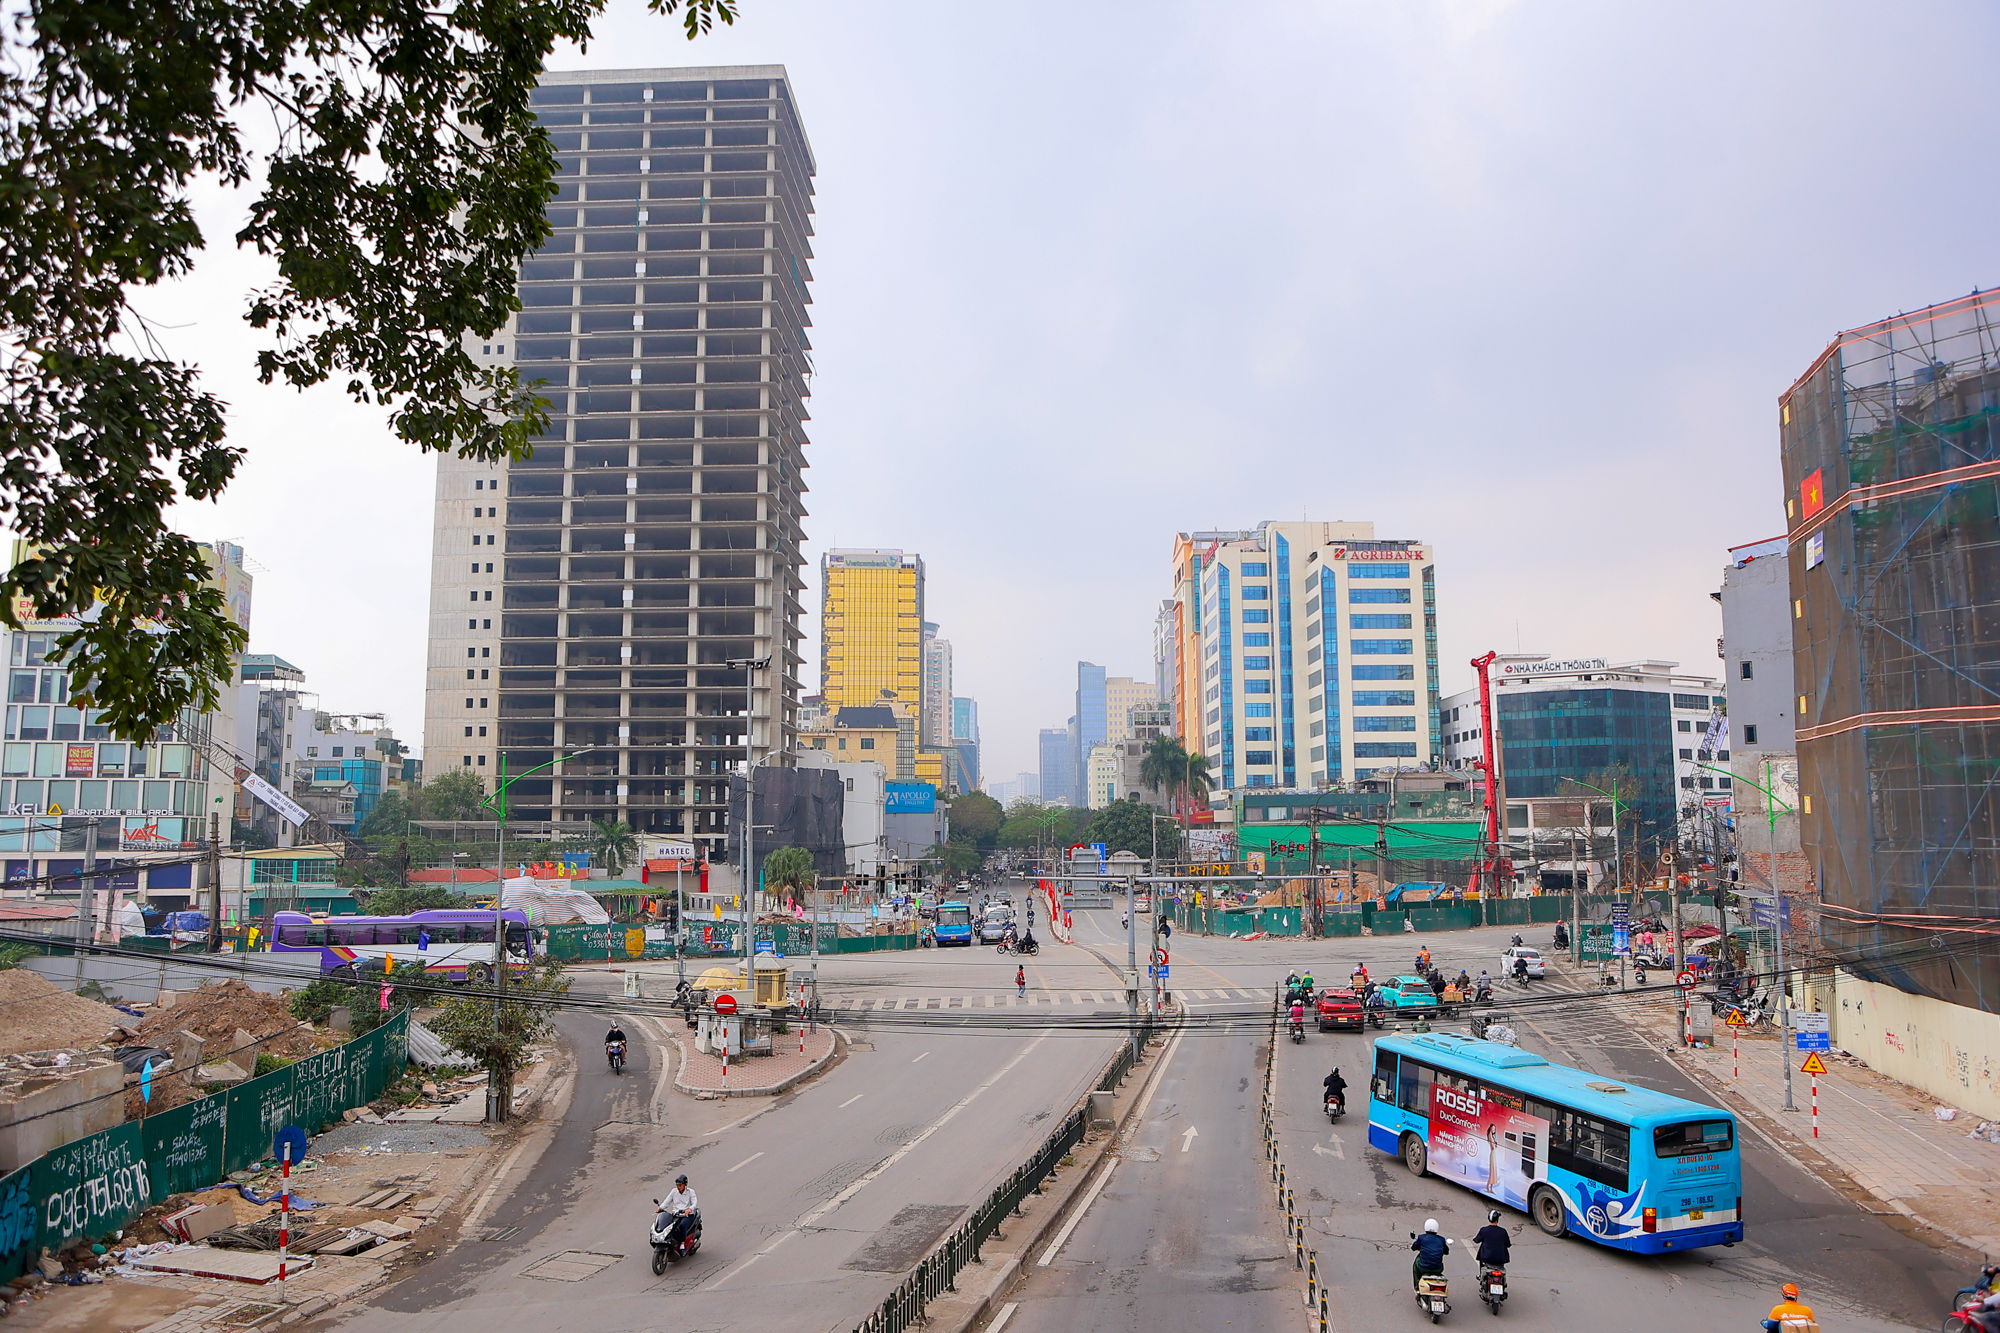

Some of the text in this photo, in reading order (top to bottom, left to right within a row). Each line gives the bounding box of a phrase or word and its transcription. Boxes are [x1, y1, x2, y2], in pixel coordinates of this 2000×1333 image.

[1350, 550, 1424, 560] AGRIBANK
[1514, 663, 1531, 673] NHÀ
[1532, 662, 1560, 672] KHÁCH
[1562, 660, 1590, 670] THÔNG
[1436, 1088, 1480, 1117] ROSSI
